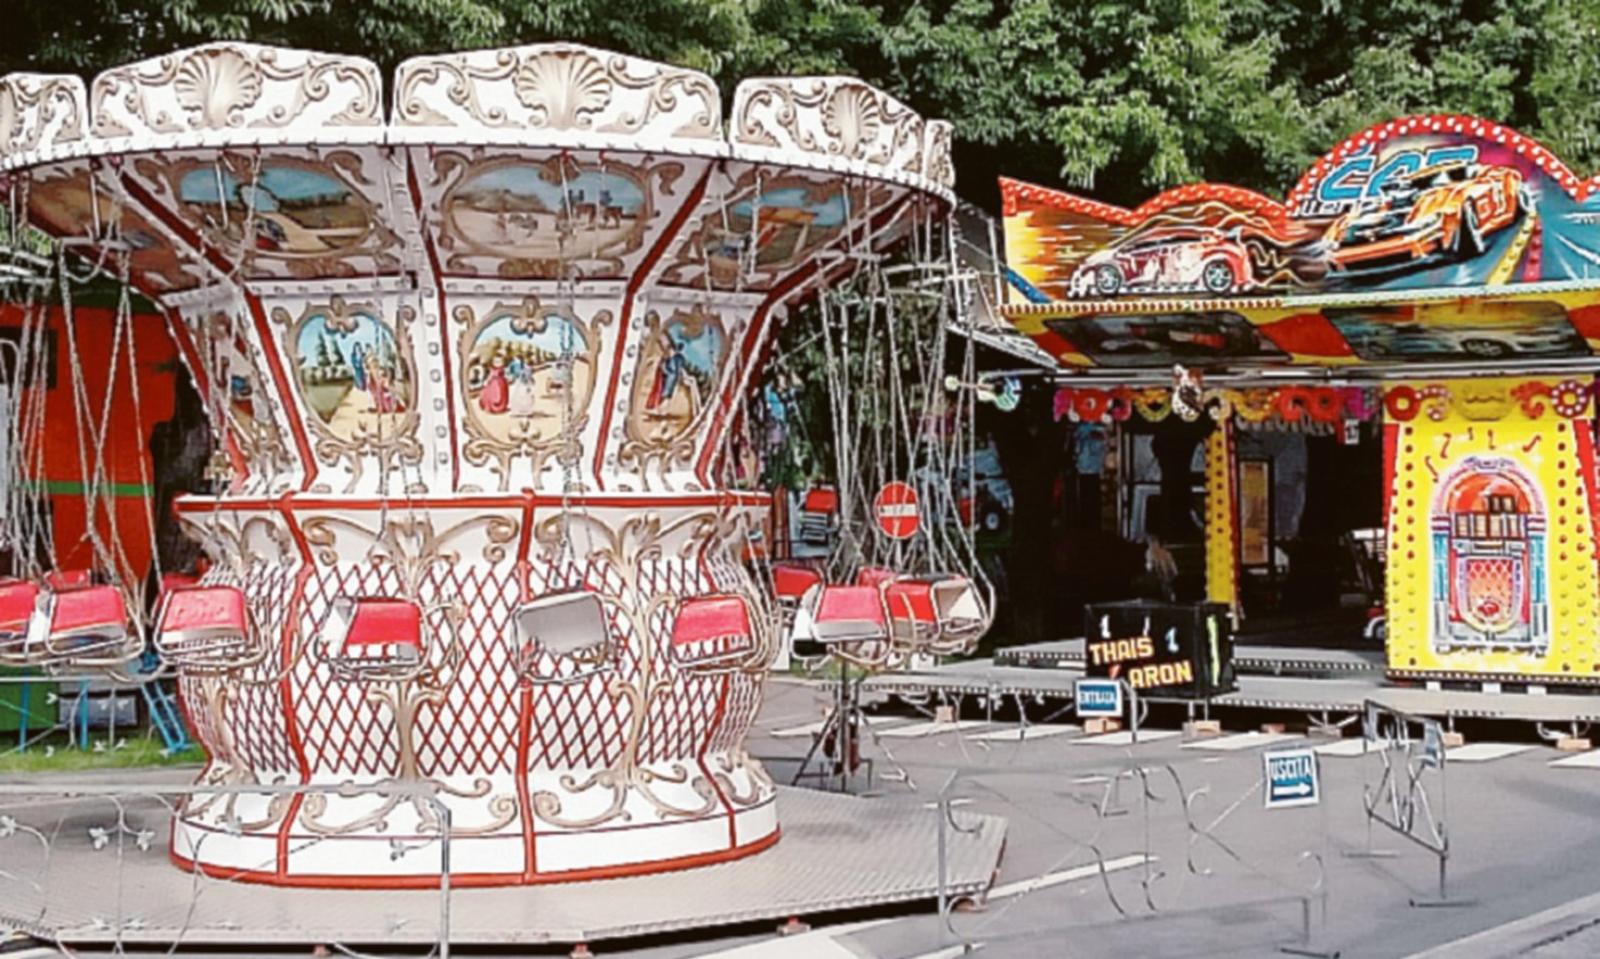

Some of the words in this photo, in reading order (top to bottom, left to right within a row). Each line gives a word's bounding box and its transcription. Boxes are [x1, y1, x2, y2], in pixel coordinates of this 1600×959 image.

[1089, 637, 1154, 666] THAIS
[1128, 661, 1193, 688] ARON
[1269, 757, 1312, 781] USCITA
